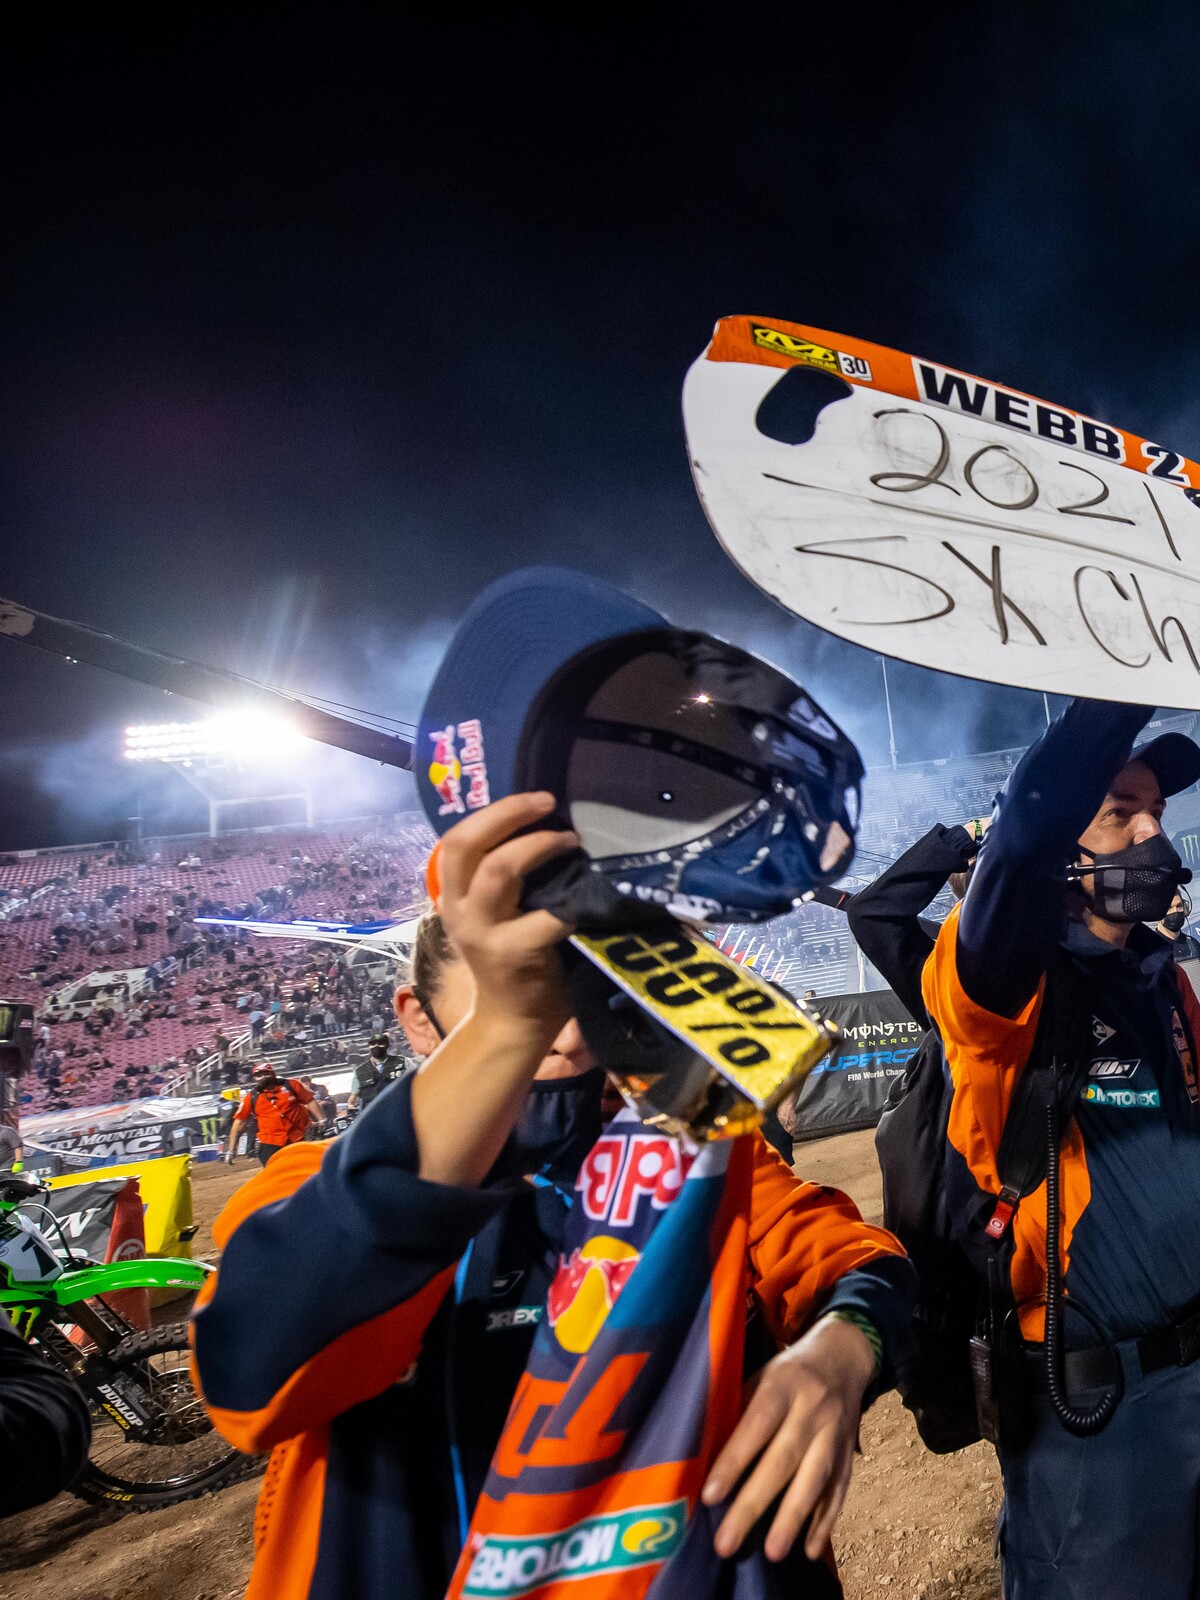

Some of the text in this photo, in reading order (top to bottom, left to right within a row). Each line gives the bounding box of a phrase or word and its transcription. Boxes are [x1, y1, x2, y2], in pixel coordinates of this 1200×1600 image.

[842, 356, 869, 376] 30
[917, 361, 1187, 484] WEBB 2
[870, 407, 1182, 562] 2021
[795, 535, 1047, 647] SX
[858, 1036, 918, 1048] ENERGY
[847, 1074, 862, 1082] FIM
[863, 1070, 884, 1079] World
[78, 1125, 163, 1148] MOUNTAIN
[97, 1384, 144, 1427] DUNLOP
